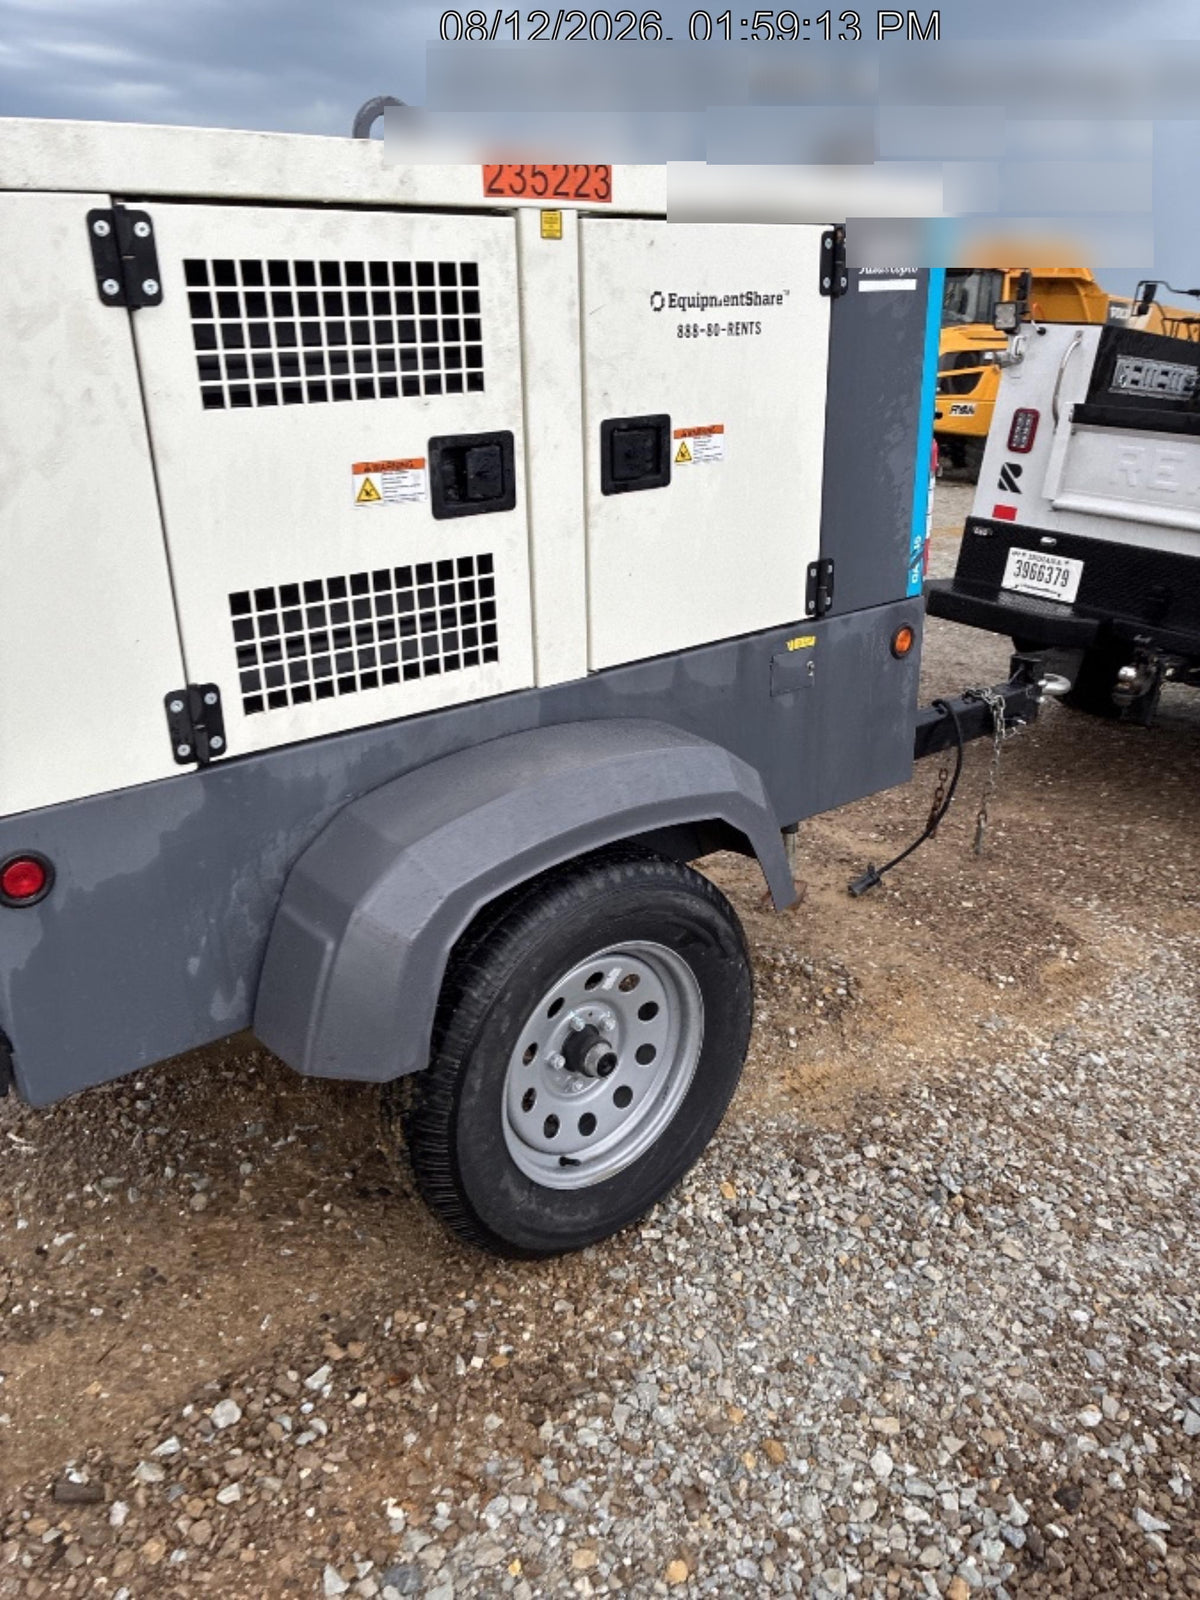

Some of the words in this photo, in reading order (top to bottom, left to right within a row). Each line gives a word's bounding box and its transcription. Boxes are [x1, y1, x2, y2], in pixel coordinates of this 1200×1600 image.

[485, 164, 611, 200] 235223
[677, 321, 762, 339] 888-80-RENTS
[1013, 559, 1070, 588] 3966379
